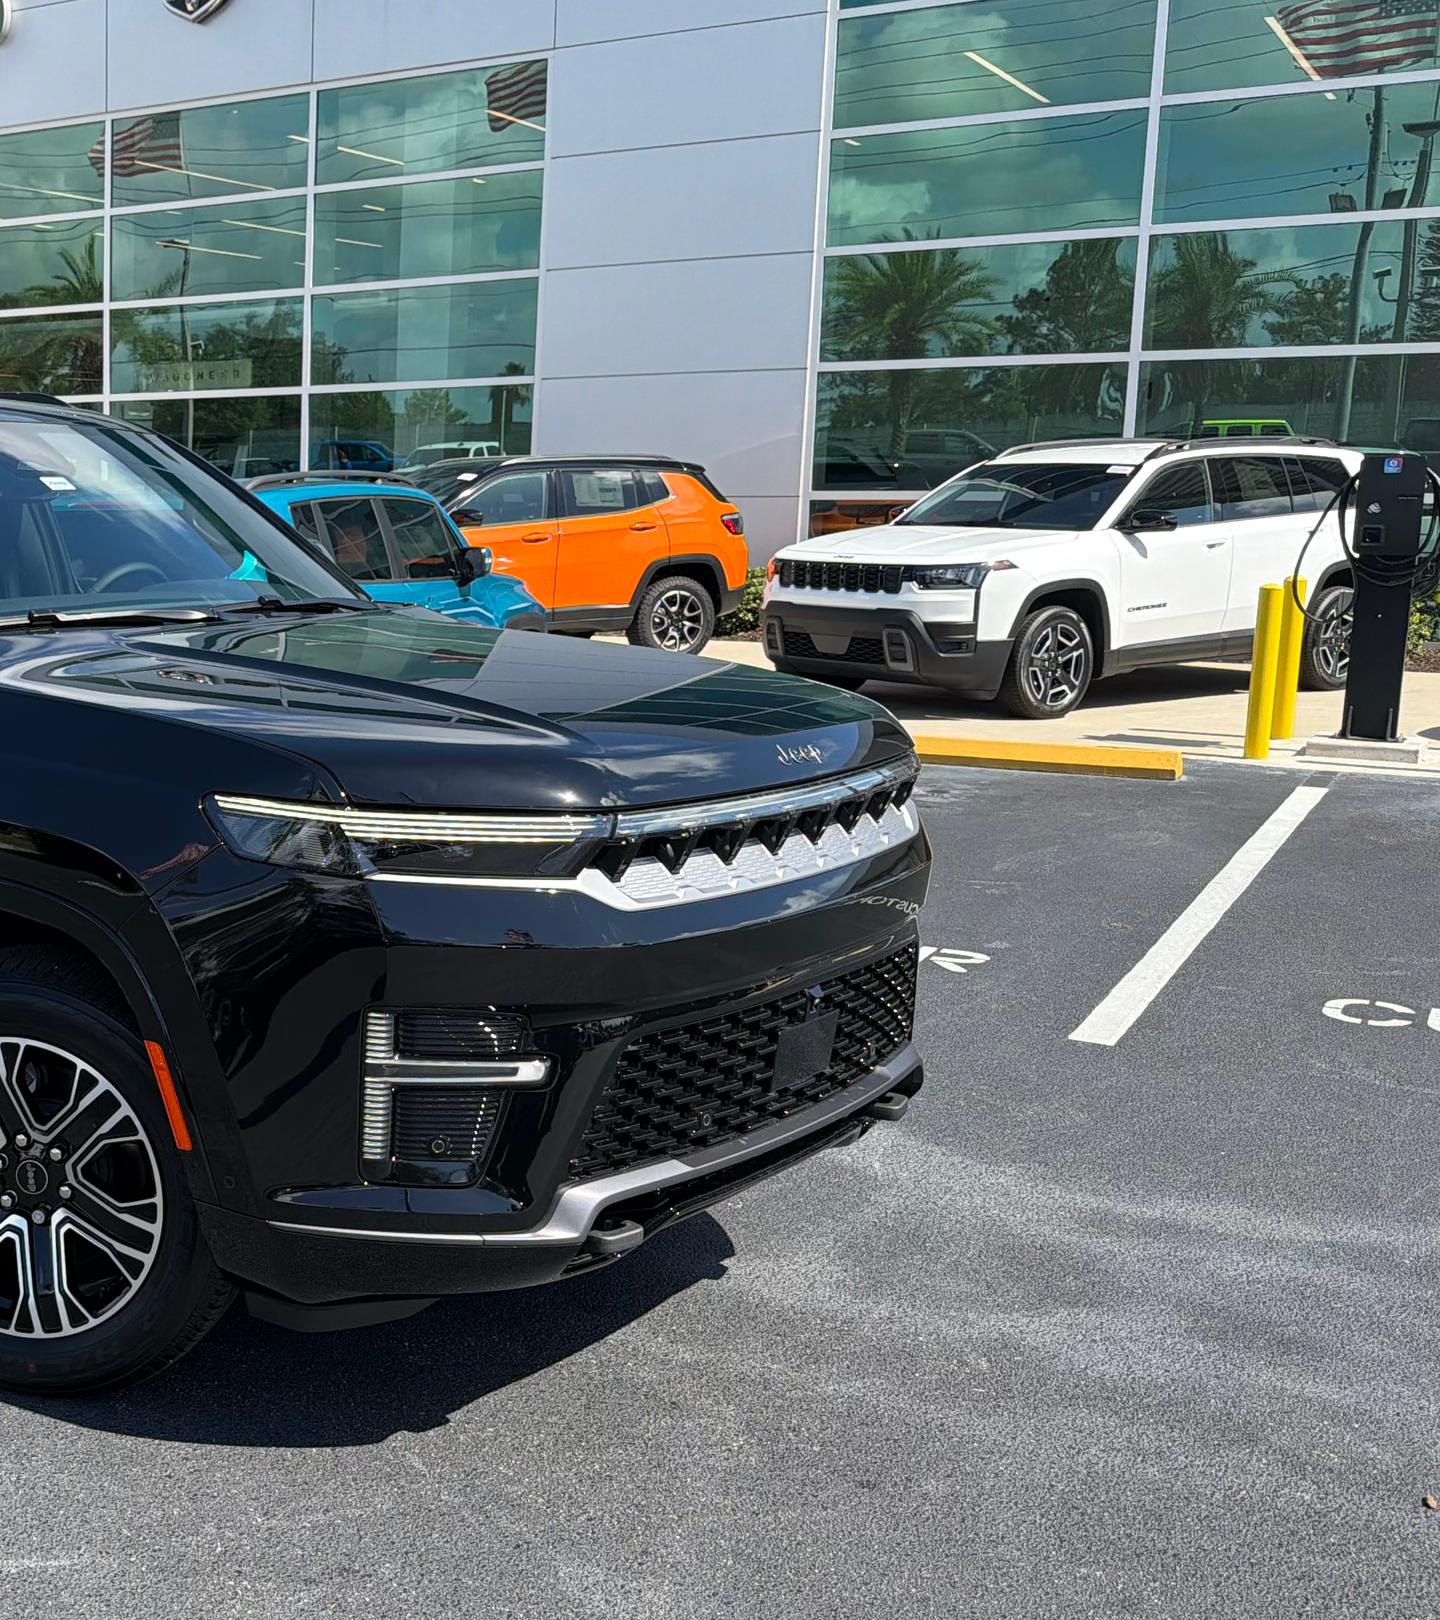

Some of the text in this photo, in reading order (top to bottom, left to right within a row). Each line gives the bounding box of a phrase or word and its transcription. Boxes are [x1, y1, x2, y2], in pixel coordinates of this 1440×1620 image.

[1127, 602, 1168, 612] CHEROKEE
[776, 743, 824, 766] Jeep
[24, 1162, 38, 1193] Jeep
